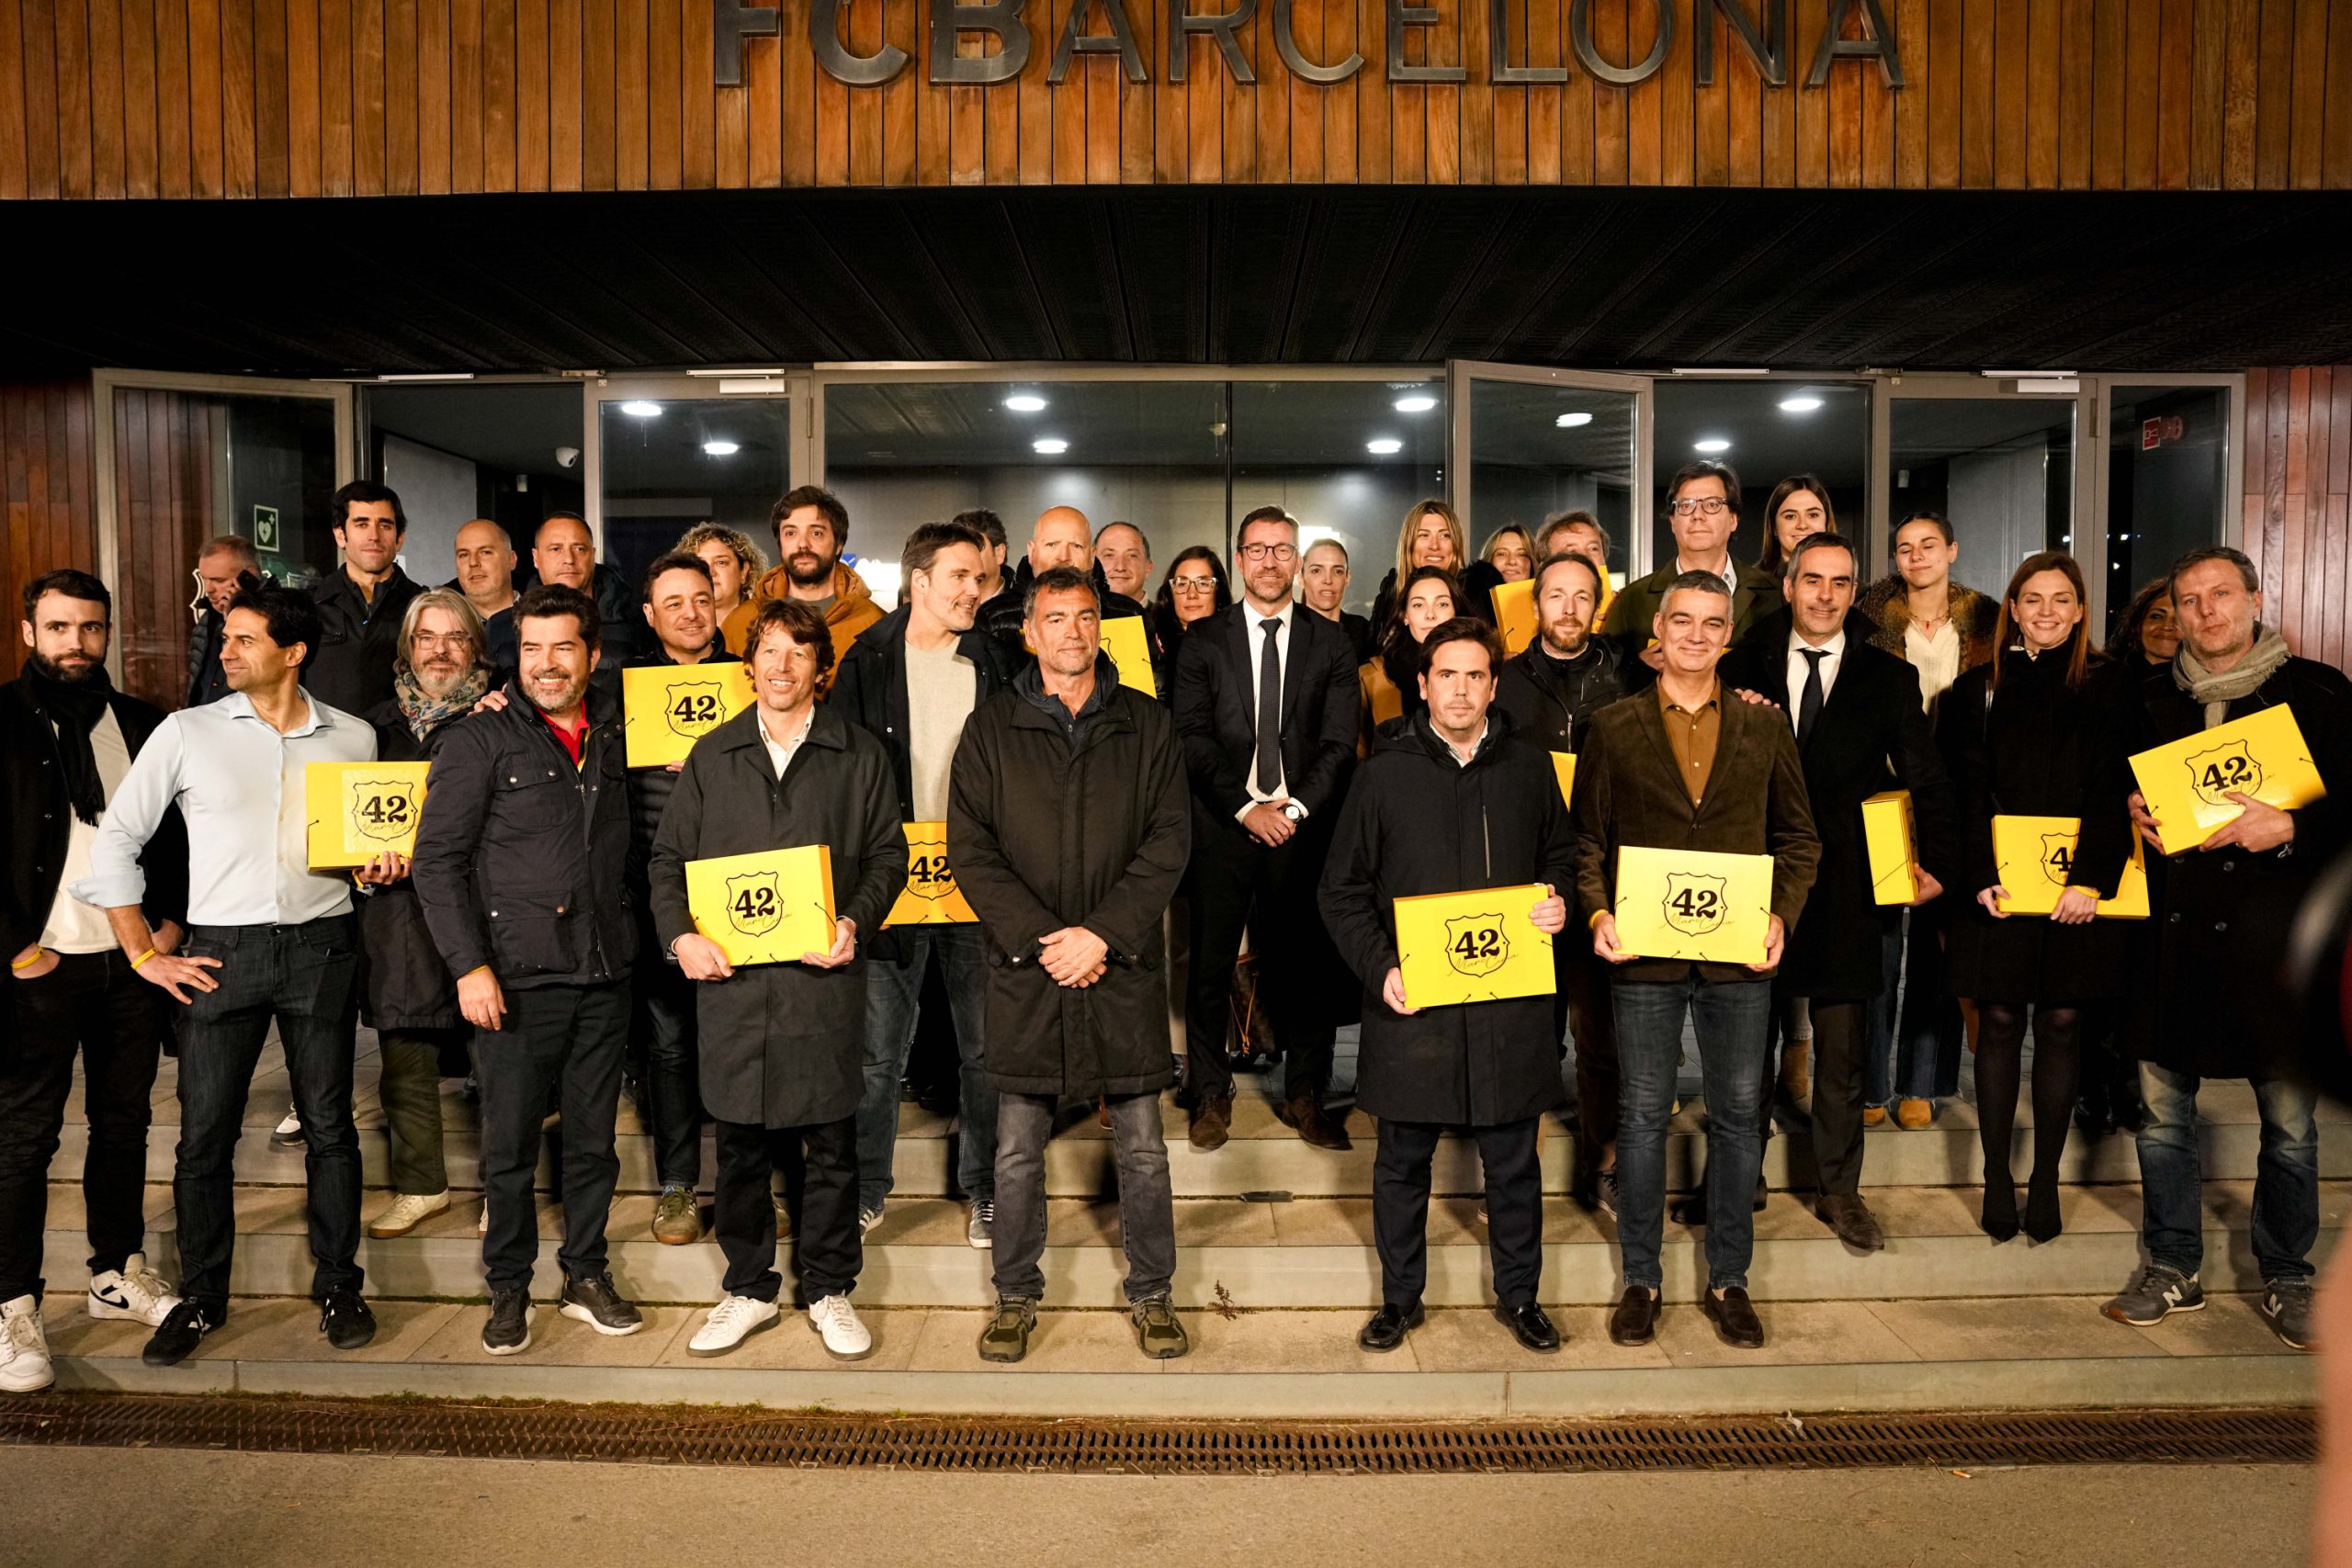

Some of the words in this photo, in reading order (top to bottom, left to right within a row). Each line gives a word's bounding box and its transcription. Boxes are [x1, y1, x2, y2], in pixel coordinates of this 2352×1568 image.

[673, 695, 717, 722] 42
[2202, 756, 2253, 792] 42
[361, 795, 408, 823] 42
[910, 855, 952, 883] 42
[2050, 846, 2075, 872] 4
[735, 887, 775, 919] 42
[1671, 887, 1718, 919] 42
[1454, 928, 1500, 960] 42
